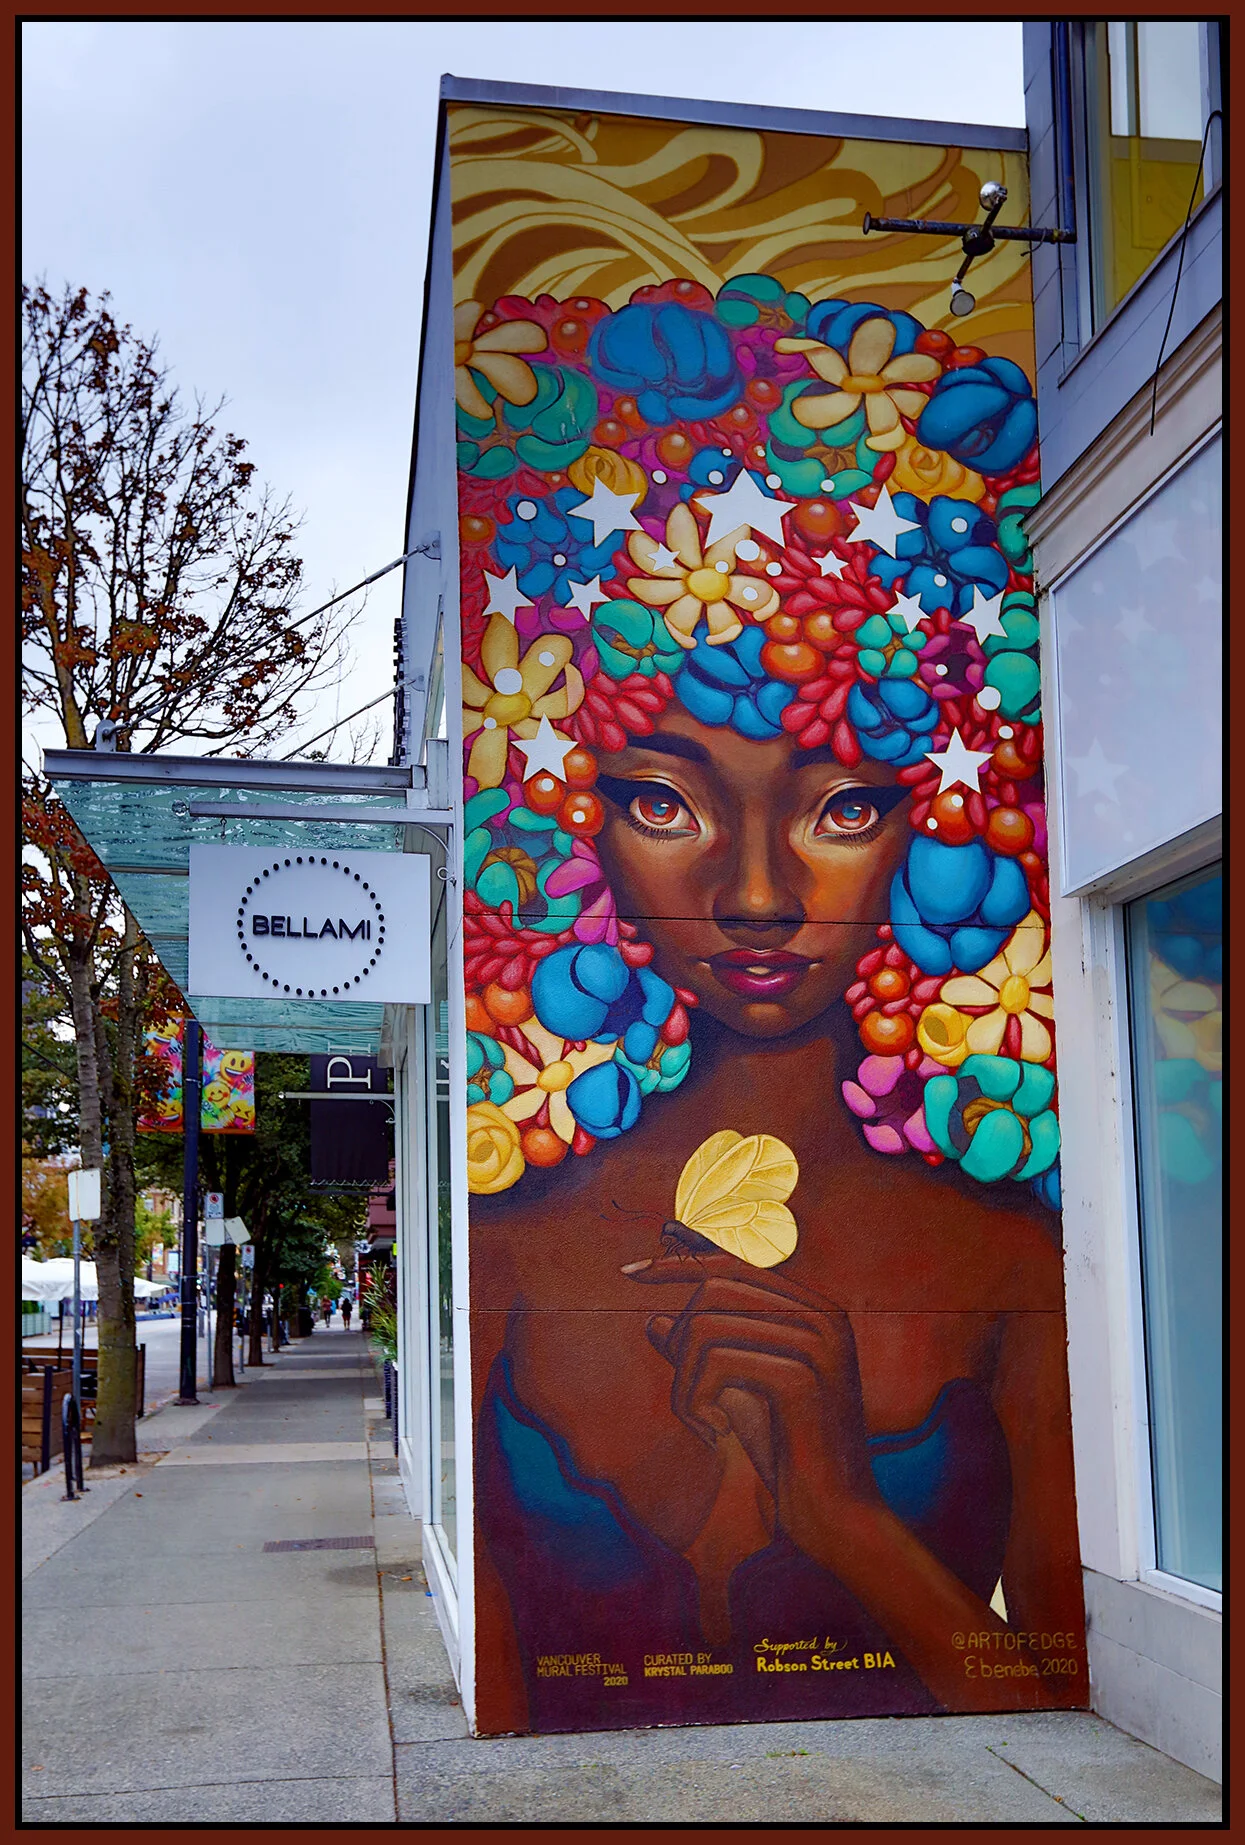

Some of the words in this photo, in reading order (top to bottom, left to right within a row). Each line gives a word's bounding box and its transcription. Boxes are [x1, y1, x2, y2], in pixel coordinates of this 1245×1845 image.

[252, 914, 371, 941] BELLAMI
[753, 1636, 821, 1656] Supported
[820, 1636, 848, 1656] by
[951, 1631, 1078, 1651] @ARTOFEDGE
[536, 1653, 602, 1667] VANCOUVER
[643, 1653, 693, 1666] CURATED
[697, 1652, 713, 1664] BY
[756, 1656, 808, 1673] Robson
[810, 1655, 860, 1671] Street
[863, 1651, 896, 1669] BIA
[964, 1655, 1038, 1678] Ebenebe
[1041, 1657, 1079, 1676] 2020
[536, 1665, 573, 1678] MURAL
[574, 1663, 627, 1677] FESTIVAL
[643, 1666, 687, 1677] KRYSTAL
[690, 1663, 734, 1676] PARABOO
[603, 1676, 629, 1687] 2020
